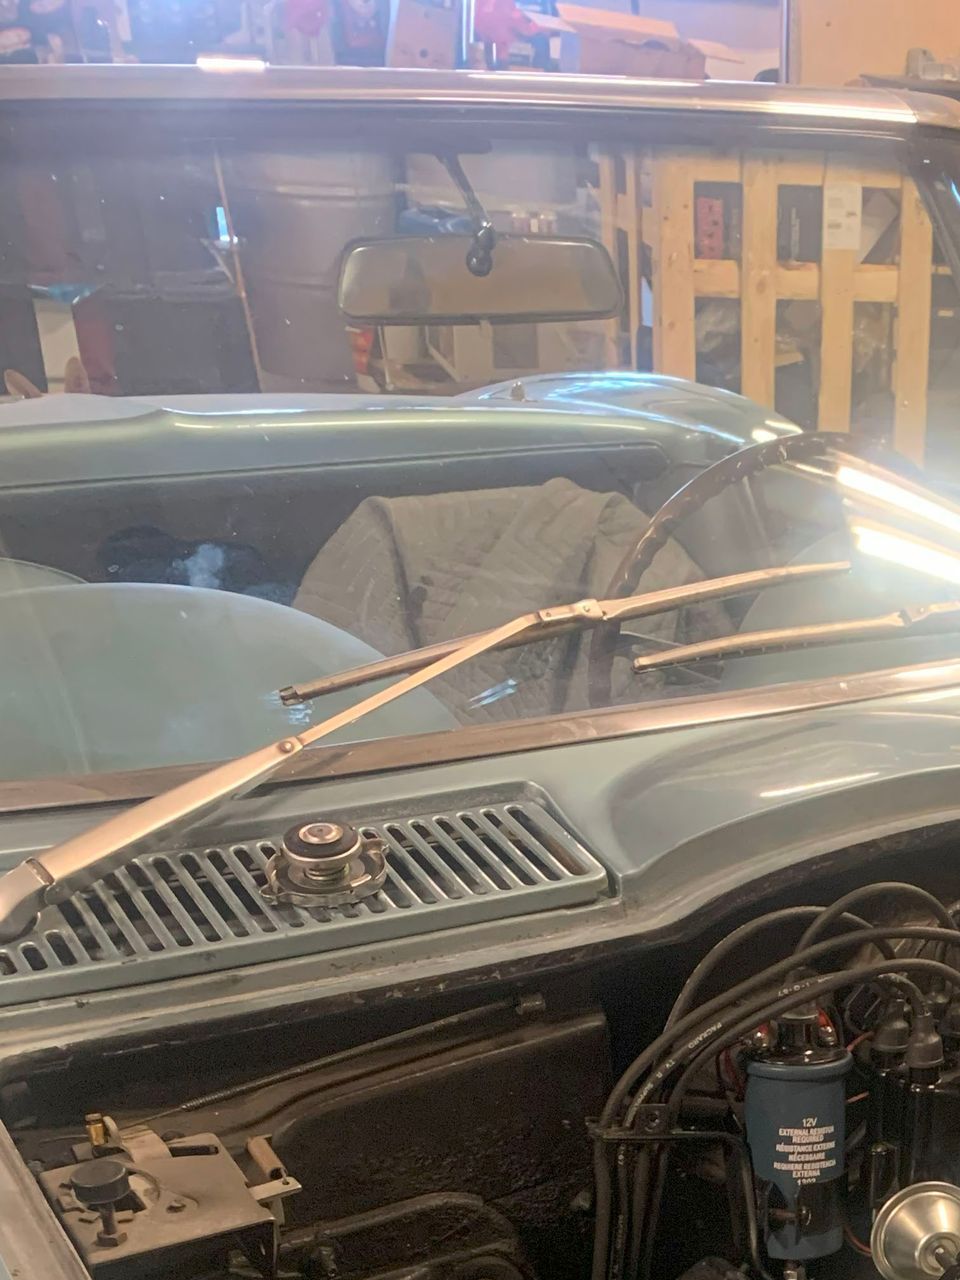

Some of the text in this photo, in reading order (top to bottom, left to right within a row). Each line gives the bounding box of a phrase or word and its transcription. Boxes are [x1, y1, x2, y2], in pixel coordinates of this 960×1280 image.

[688, 1022, 722, 1049] PACKARD
[802, 1117, 818, 1128] 12V
[779, 1126, 834, 1136] EXTERNAL RESISTOR
[792, 1134, 824, 1143] REQUIRED
[792, 1169, 820, 1178] EXTERNA
